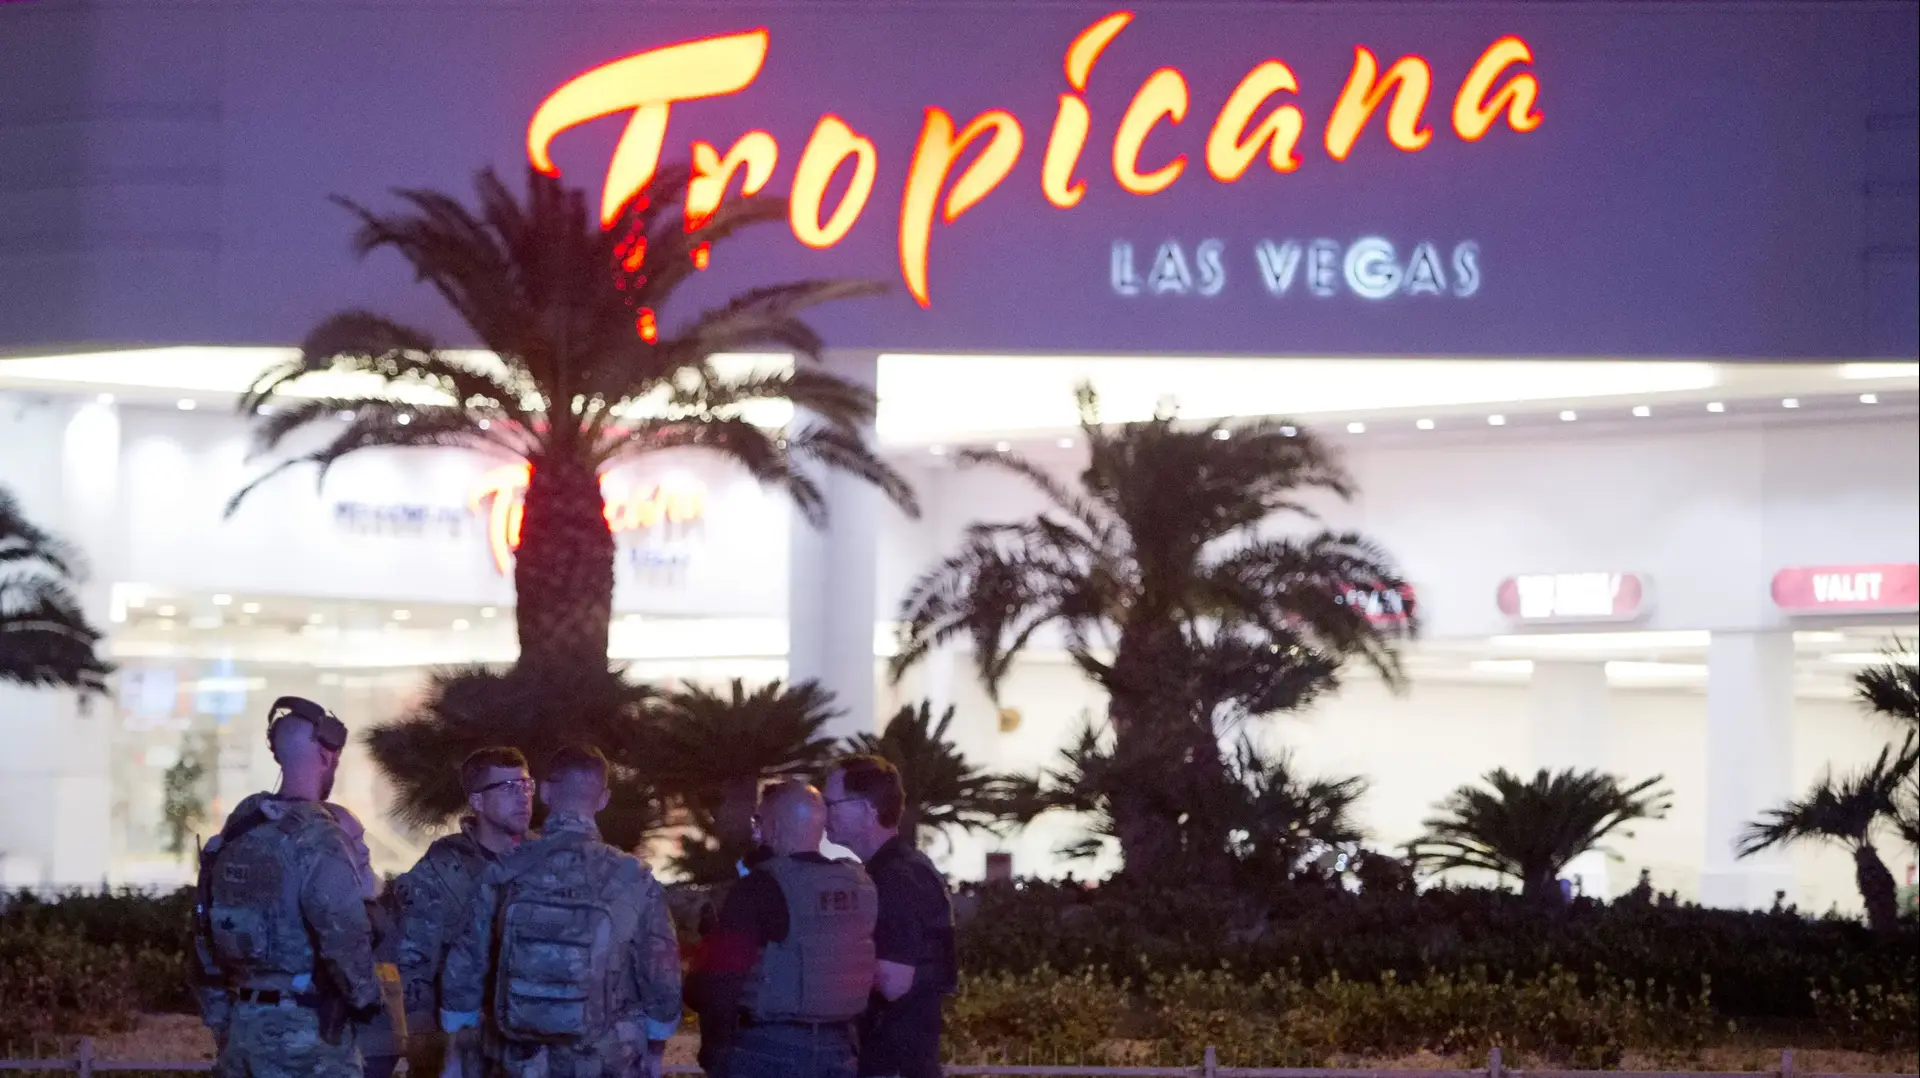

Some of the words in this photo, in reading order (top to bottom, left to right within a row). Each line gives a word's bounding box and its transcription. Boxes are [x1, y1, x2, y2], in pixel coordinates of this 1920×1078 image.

[527, 10, 1545, 342] Tropicana
[1109, 237, 1227, 298] LAS
[1254, 234, 1481, 301] VEGAS
[1812, 571, 1883, 603] VALET
[226, 867, 249, 880] FBI
